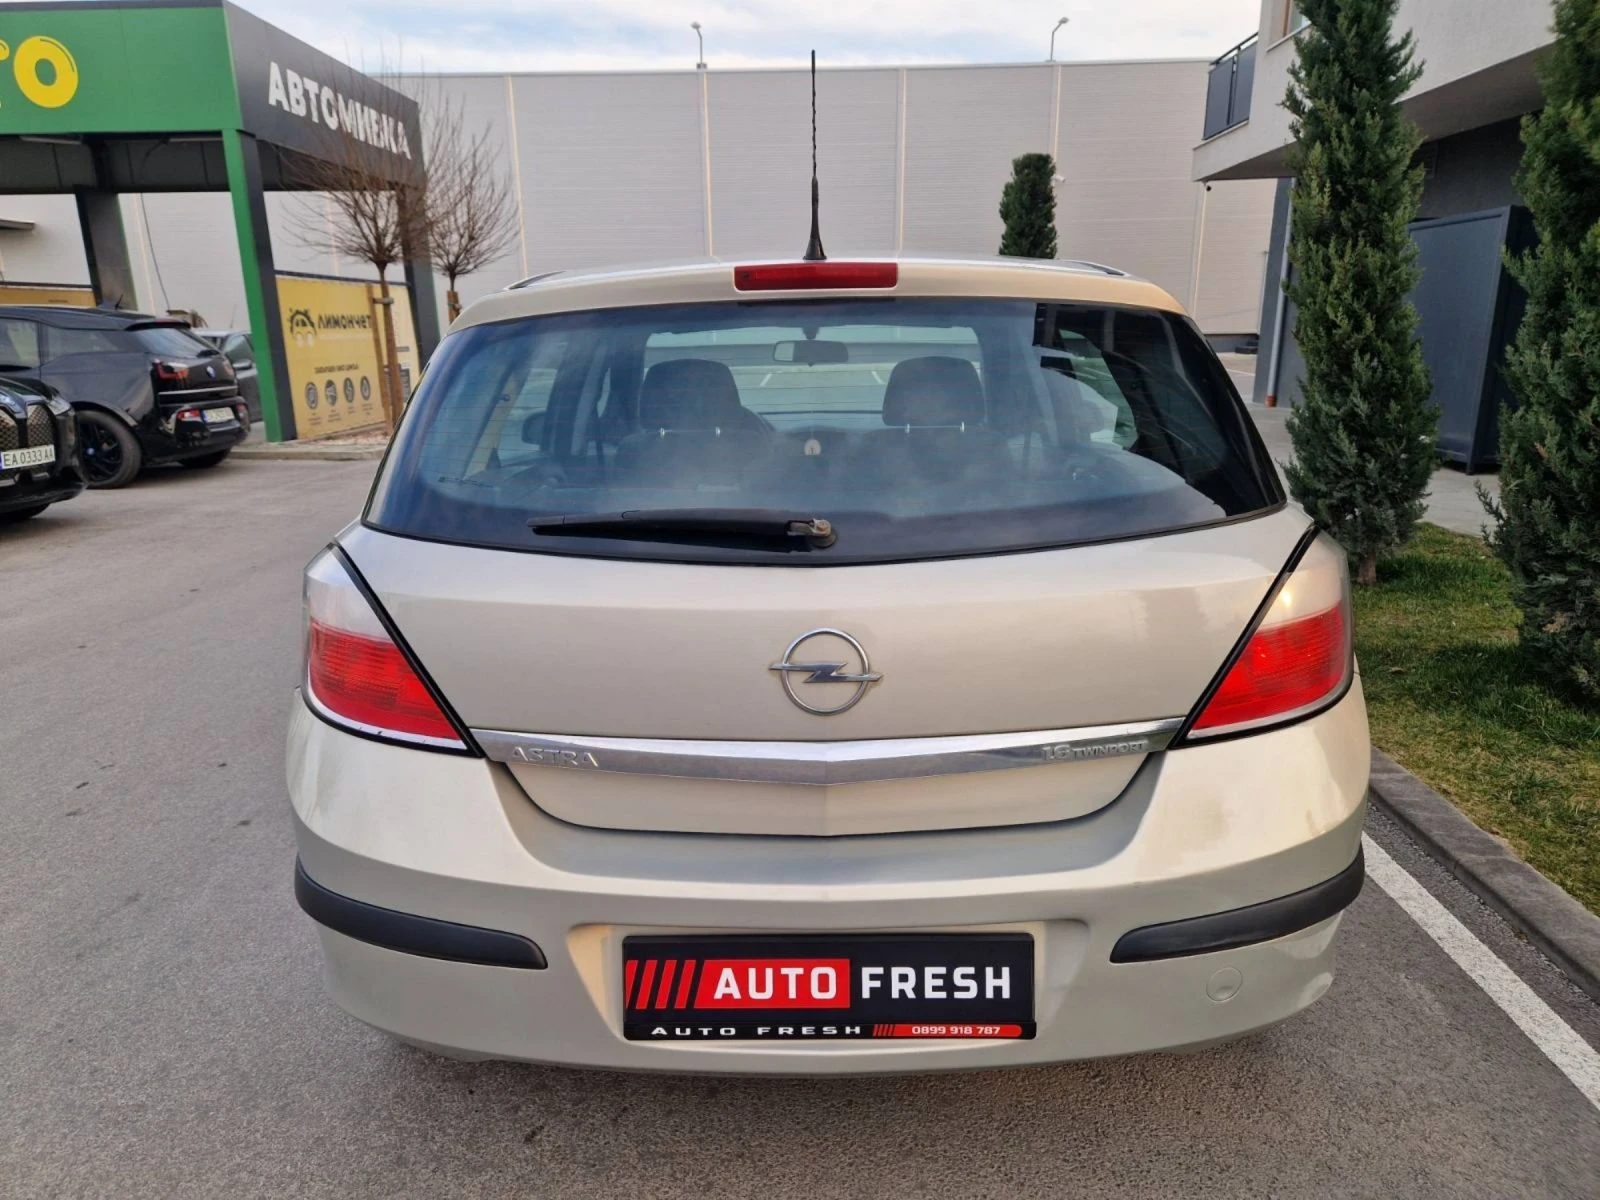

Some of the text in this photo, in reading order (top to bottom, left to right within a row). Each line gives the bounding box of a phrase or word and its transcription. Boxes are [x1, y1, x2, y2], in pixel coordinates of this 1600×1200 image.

[512, 746, 599, 767] ASTRA
[1072, 739, 1149, 759] TWINPORT
[713, 966, 1011, 1000] AUTO FRESH
[651, 1026, 862, 1036] AUTO FRESH
[911, 1026, 1001, 1035] 0899 918 787
